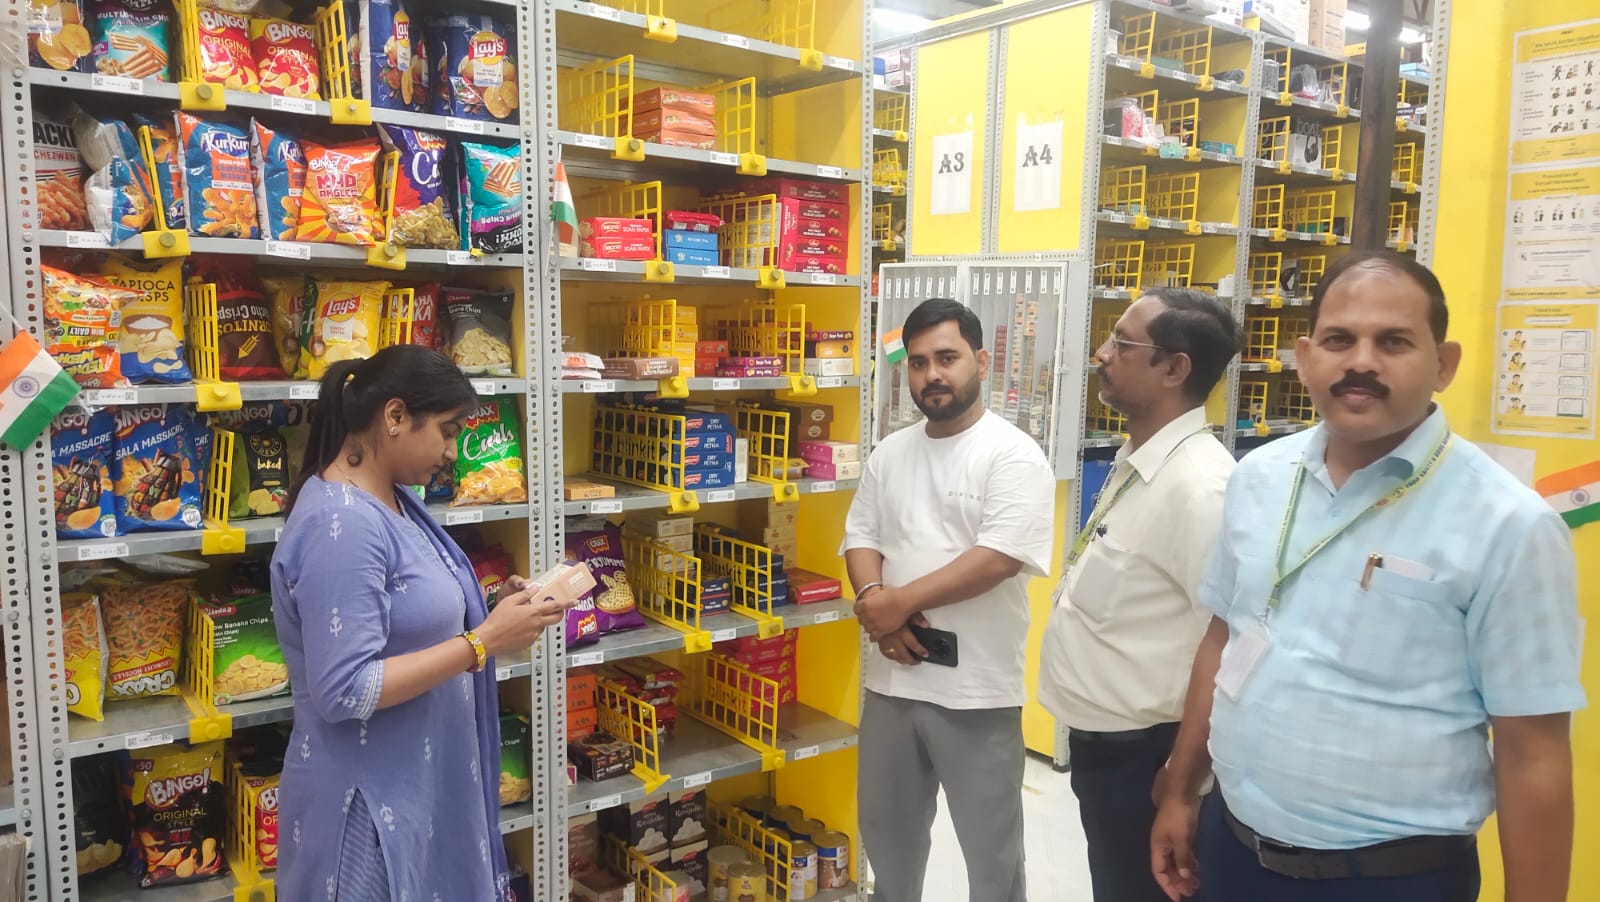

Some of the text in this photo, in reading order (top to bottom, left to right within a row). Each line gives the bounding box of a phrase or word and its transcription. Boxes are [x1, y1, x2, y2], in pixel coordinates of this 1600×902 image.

[199, 10, 248, 38] BINGO!
[267, 23, 315, 49] BINGO!
[202, 34, 252, 60] ORIGINAL
[202, 131, 250, 154] Kurkur
[938, 152, 965, 174] A3
[1022, 144, 1053, 168] A4
[51, 411, 91, 435] NGO!
[59, 431, 112, 457] MASSACRE
[115, 442, 140, 462] SALA
[224, 616, 269, 630] Banana Chips
[111, 669, 175, 696] CRAX
[150, 767, 210, 806] BINGO!
[153, 807, 208, 822] ORIGINAL
